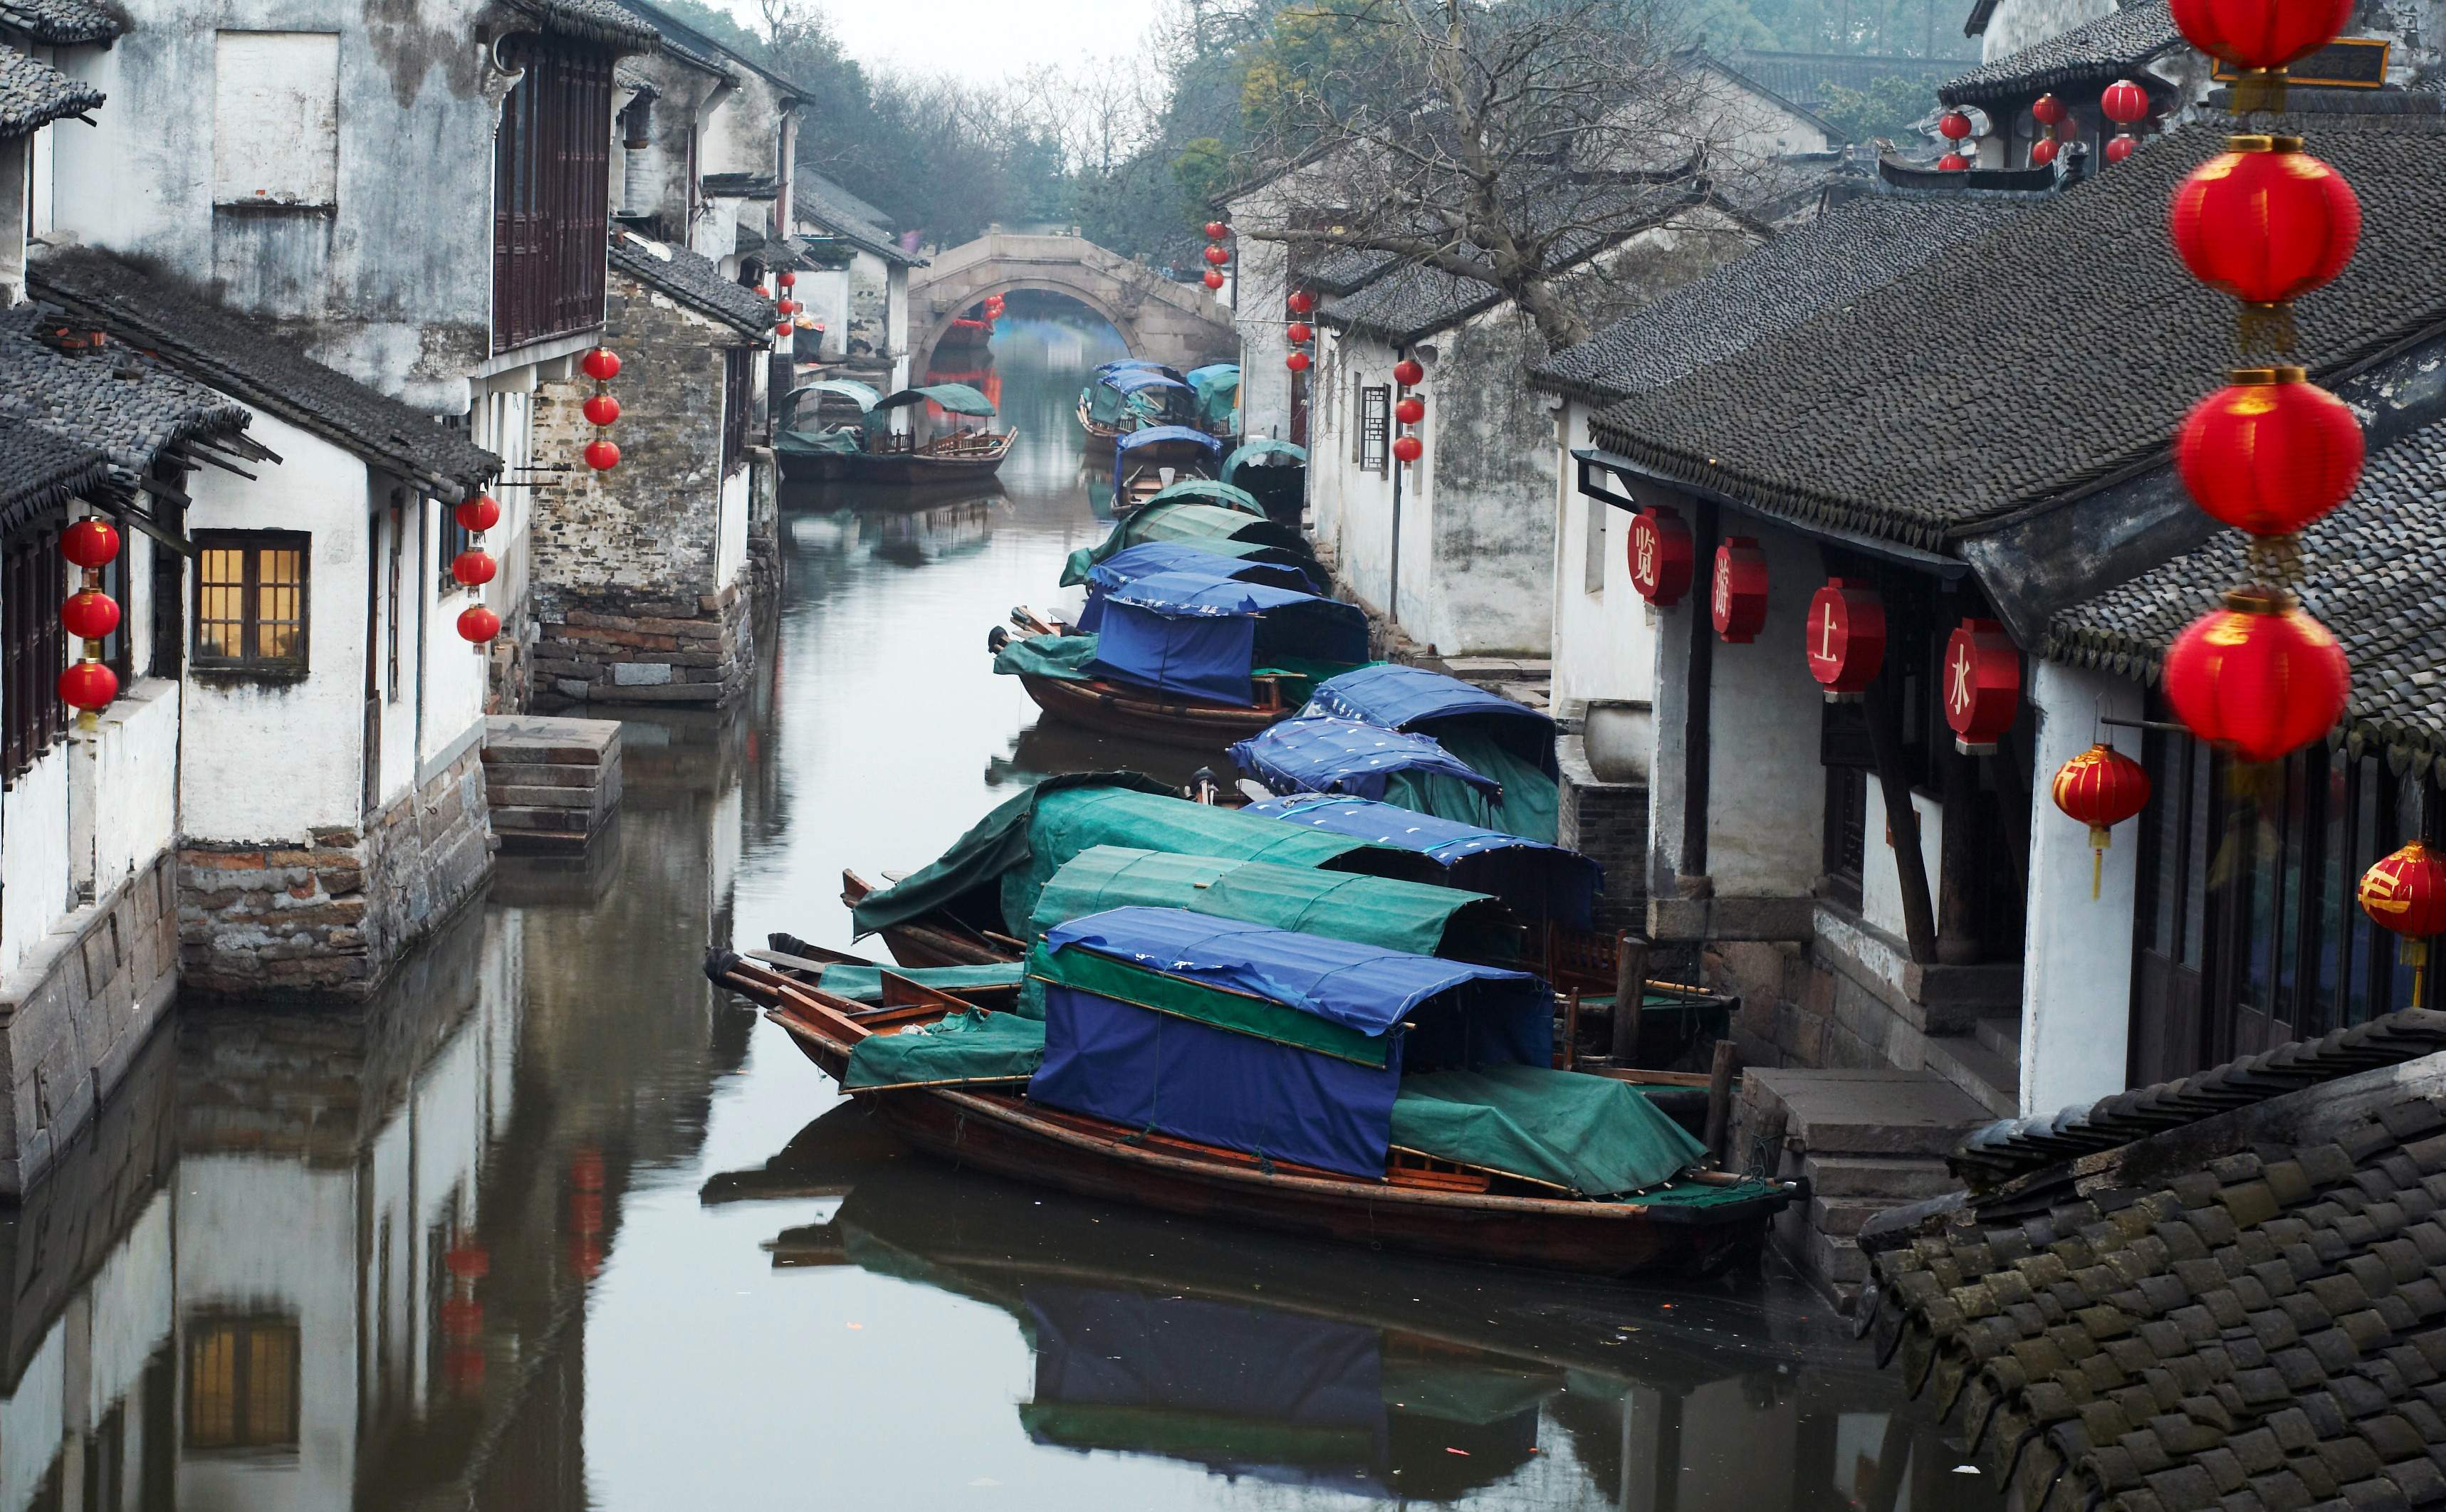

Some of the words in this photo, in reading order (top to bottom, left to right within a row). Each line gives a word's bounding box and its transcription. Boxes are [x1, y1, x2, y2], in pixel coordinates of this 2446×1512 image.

[1635, 525, 1656, 587] 览
[1715, 557, 1730, 618] 游
[1814, 602, 1837, 662] 上
[1950, 643, 1970, 715] 水
